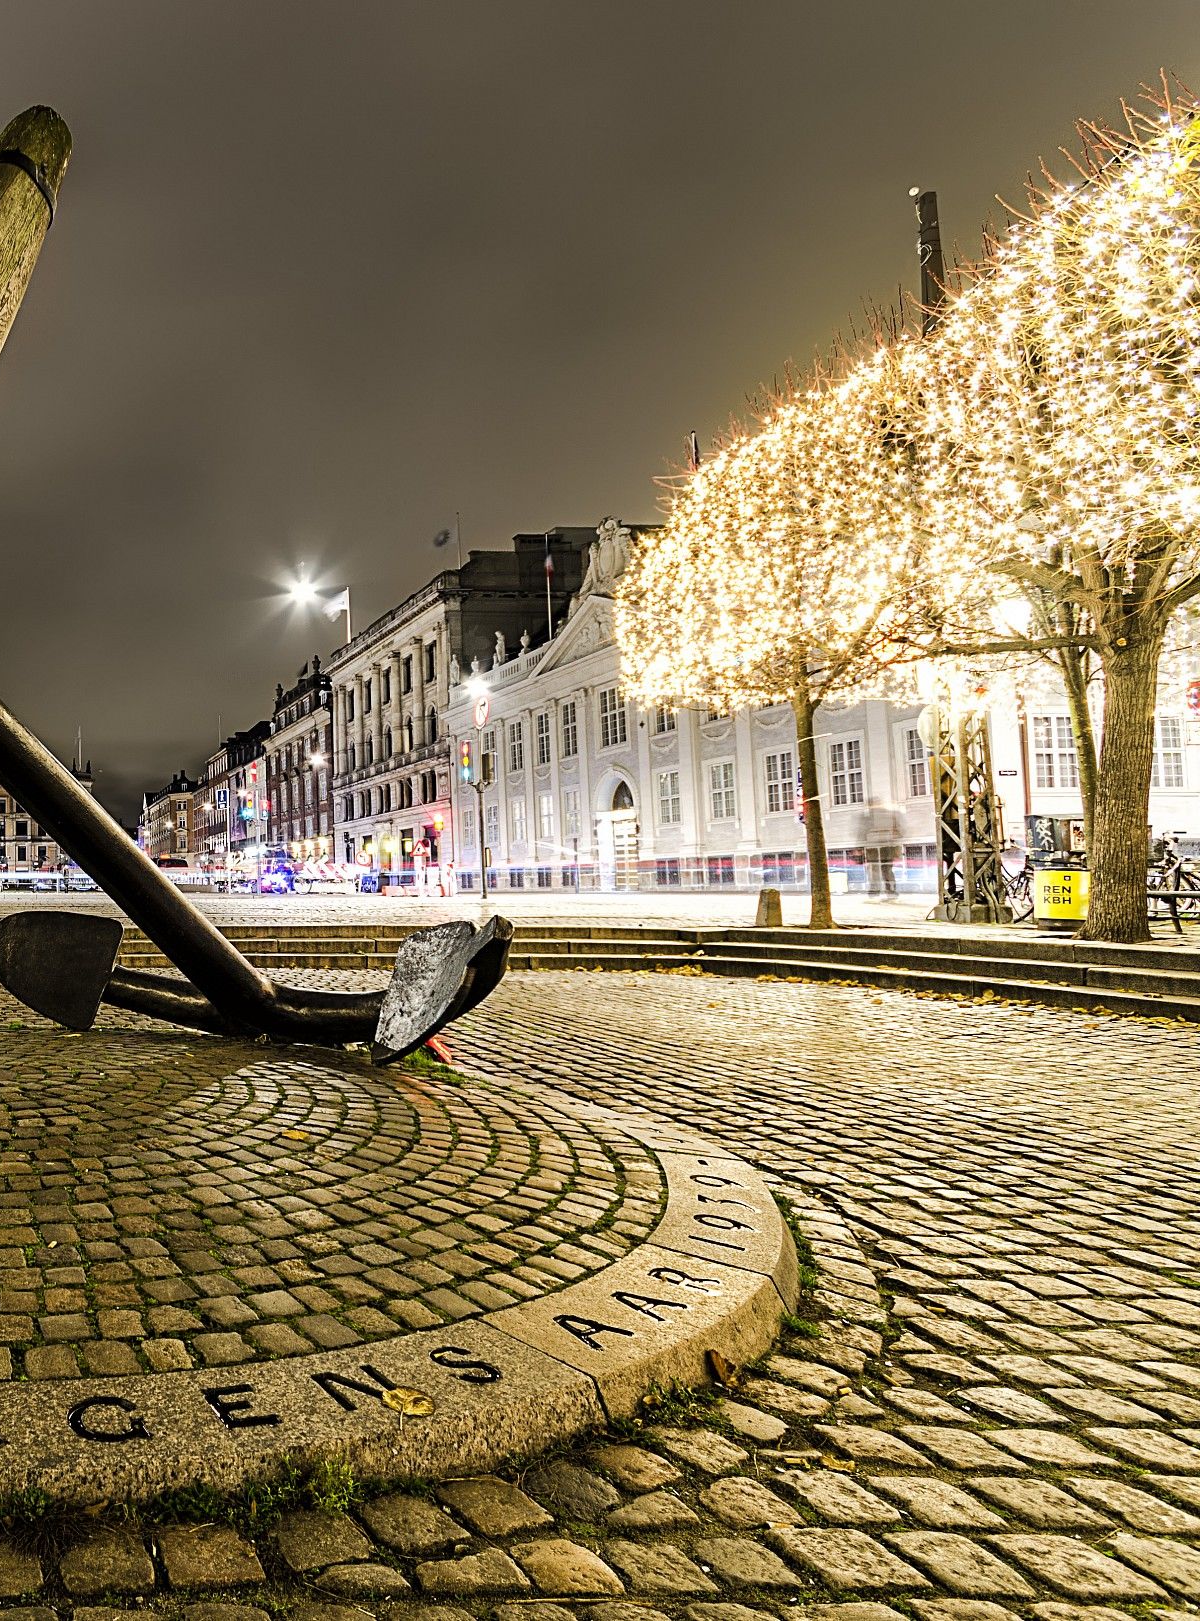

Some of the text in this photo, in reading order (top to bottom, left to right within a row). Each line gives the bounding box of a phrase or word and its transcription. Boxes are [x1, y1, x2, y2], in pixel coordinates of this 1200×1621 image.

[1043, 885, 1072, 894] REN
[1043, 896, 1072, 904] KBH
[552, 1267, 721, 1352] AAR
